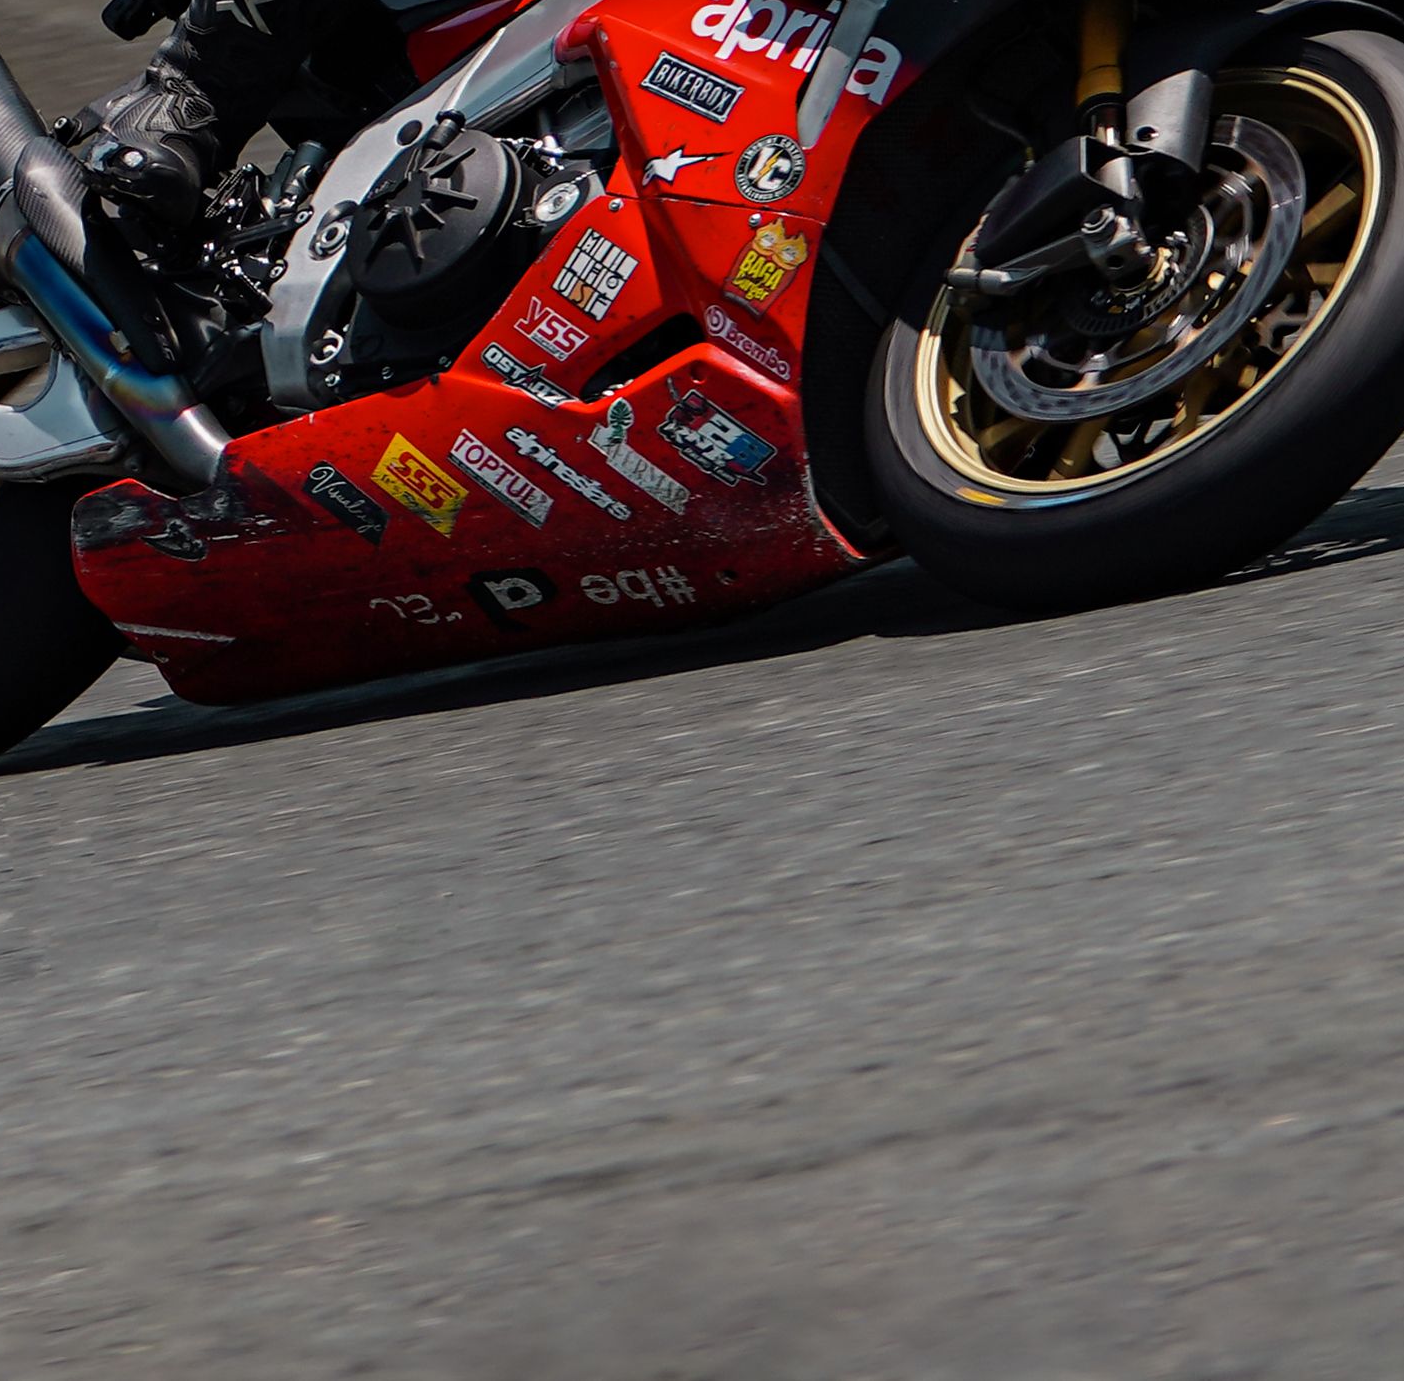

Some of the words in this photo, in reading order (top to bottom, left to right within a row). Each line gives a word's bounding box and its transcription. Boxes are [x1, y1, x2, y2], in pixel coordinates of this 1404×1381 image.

[654, 57, 733, 113] BIKERBOX
[739, 250, 785, 291] BAGA
[514, 297, 587, 355] YSS
[726, 318, 790, 378] brembo
[483, 346, 569, 406] QSTARZ
[454, 432, 539, 509] TOPTUL
[505, 427, 632, 520] alpinestars
[579, 565, 697, 609] #be
